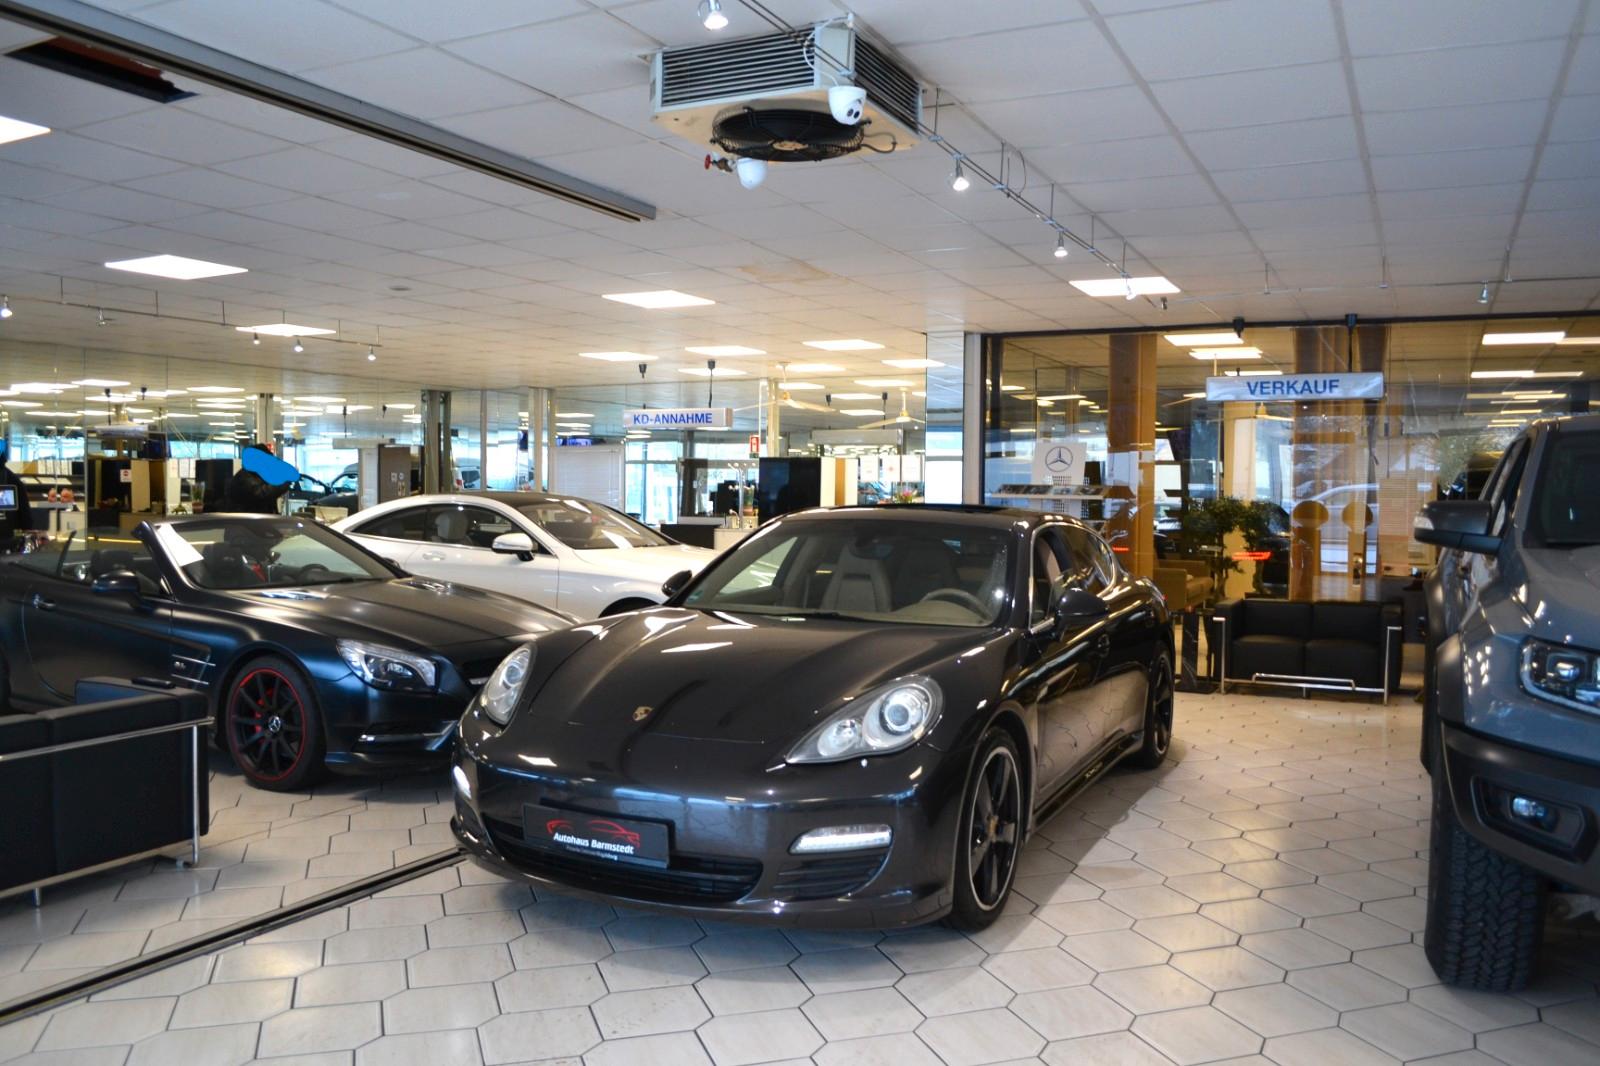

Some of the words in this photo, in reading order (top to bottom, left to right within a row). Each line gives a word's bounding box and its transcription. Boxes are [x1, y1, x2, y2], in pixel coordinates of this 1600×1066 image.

[1247, 379, 1340, 395] VERKAUF
[633, 413, 712, 424] KD-ANNAHME
[553, 832, 590, 847] Autohaus
[591, 839, 635, 854] Barmstedt
